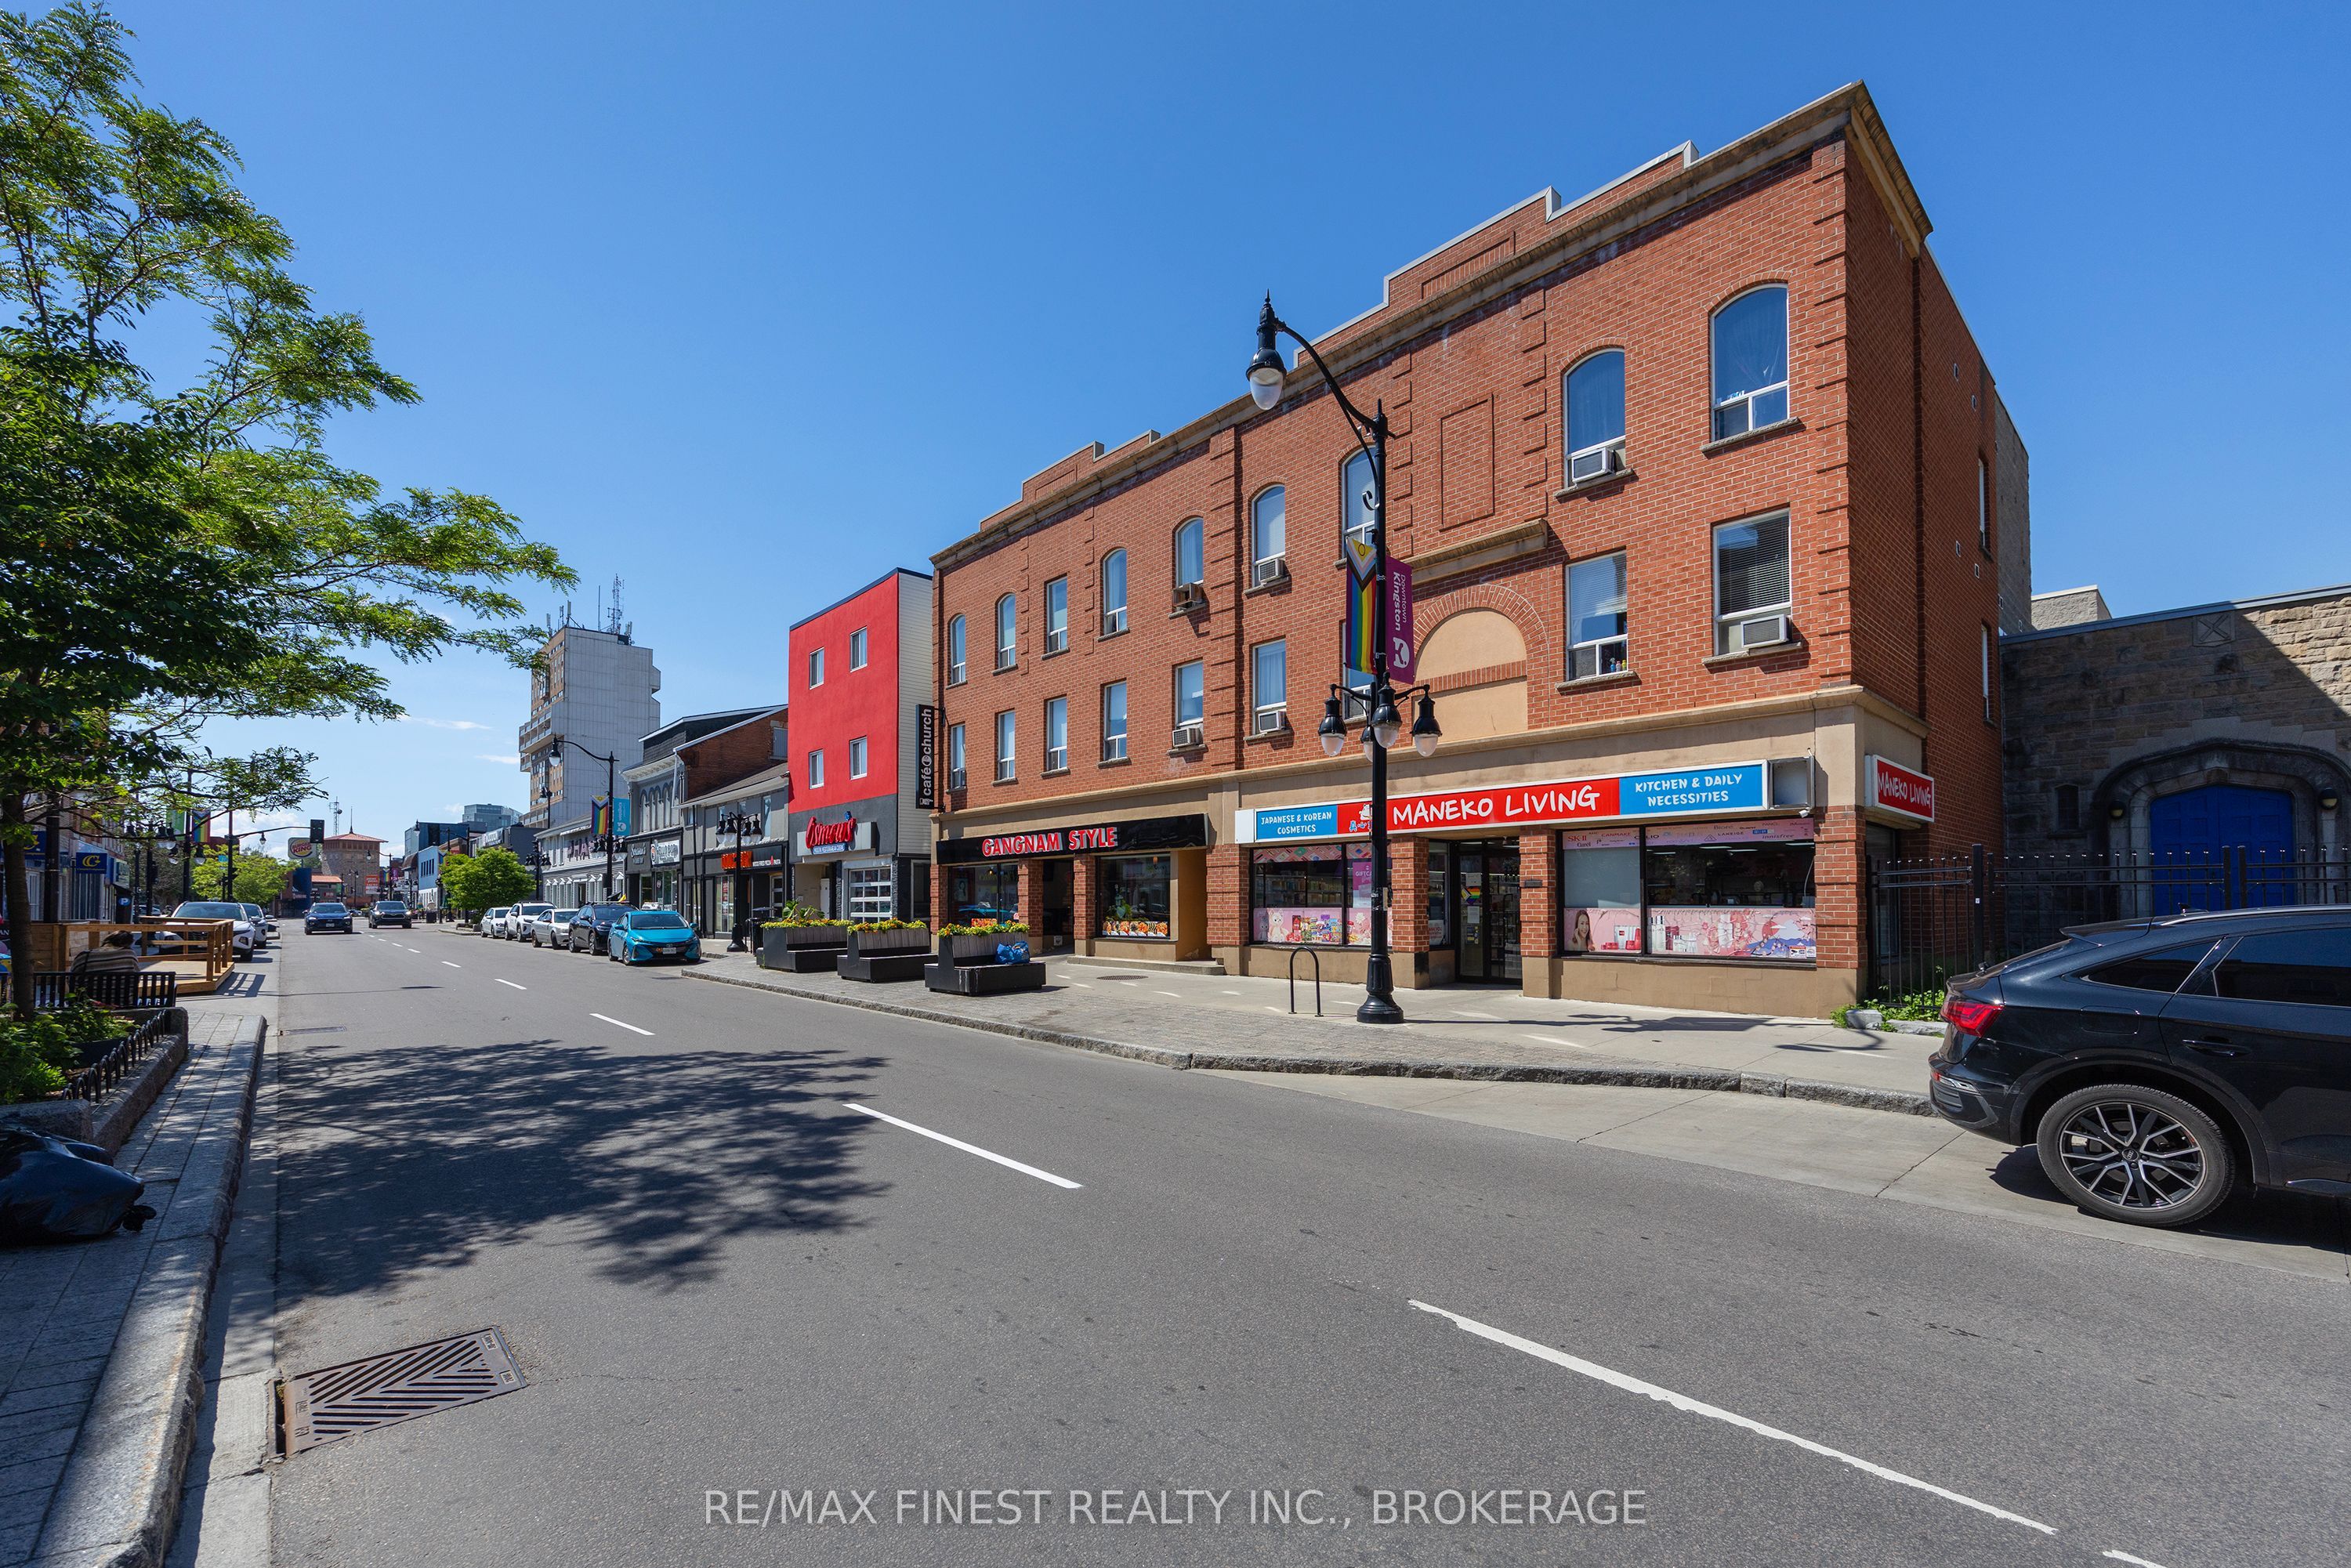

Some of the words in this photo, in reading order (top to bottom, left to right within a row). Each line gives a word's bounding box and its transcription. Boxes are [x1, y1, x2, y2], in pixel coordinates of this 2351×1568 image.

[1393, 571, 1402, 632] Kingston
[921, 708, 932, 753] church
[921, 769, 932, 796] café
[1635, 778, 1688, 793] KITCHEN
[1691, 777, 1701, 788] &
[1704, 773, 1743, 788] DAILY
[1878, 770, 1908, 800] MANEKO
[1909, 783, 1932, 809] LIVING
[1393, 798, 1494, 825] MANEKO
[1505, 784, 1600, 817] LIVING
[1646, 790, 1729, 807] NECESSITIES
[1261, 814, 1295, 825] JAPANESE
[1303, 811, 1332, 822] KOREAN
[1277, 824, 1317, 835] COSMETICS
[293, 845, 312, 853] KING
[982, 831, 1063, 857] GANGNAM
[1068, 827, 1118, 850] STYLE
